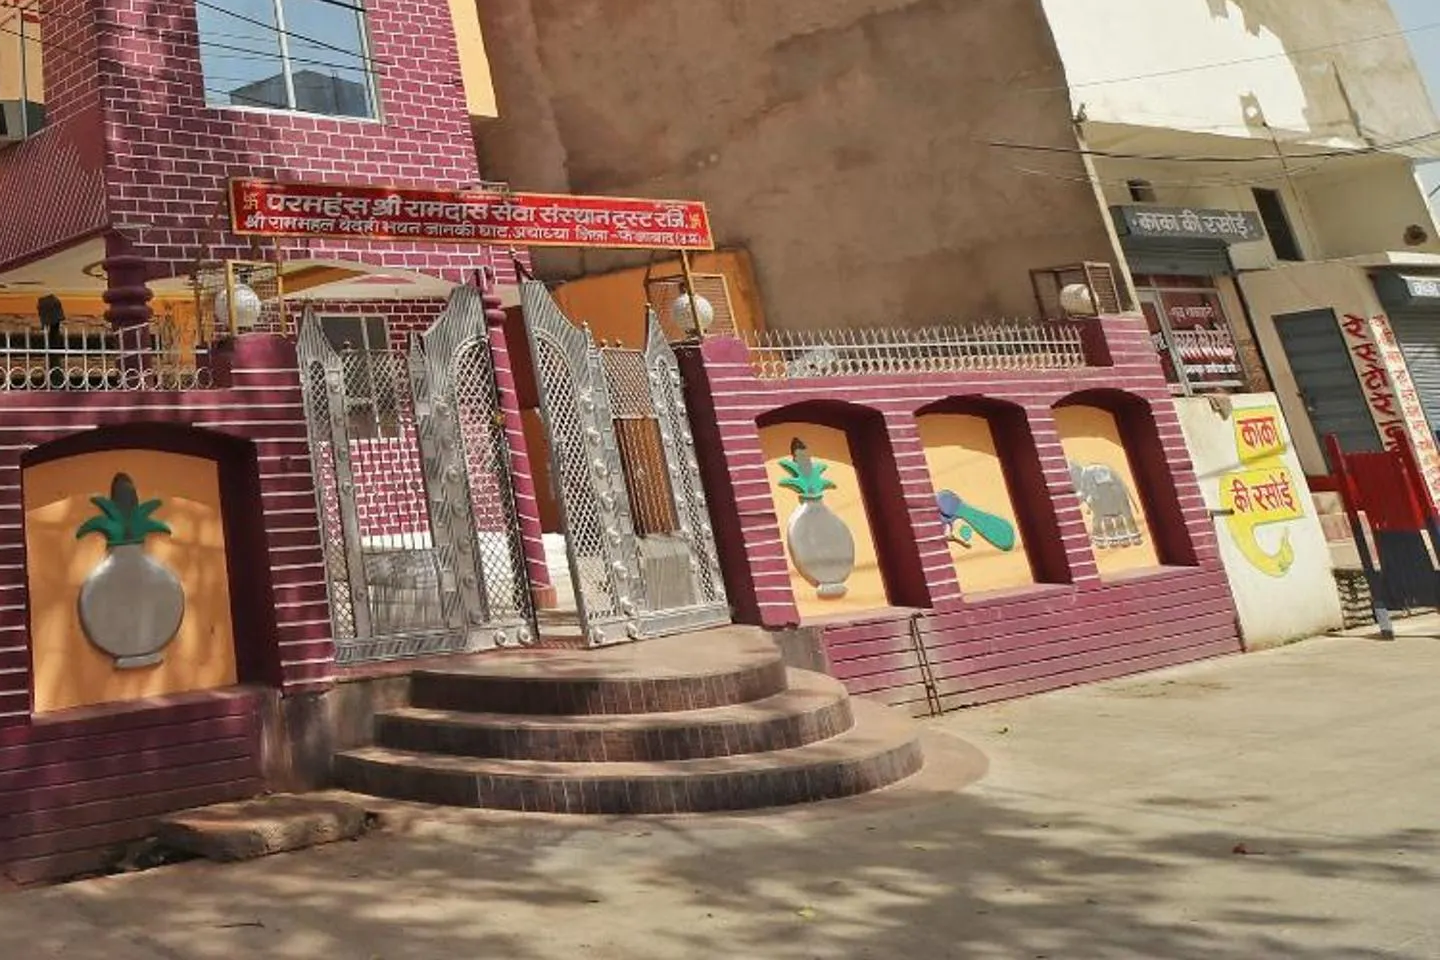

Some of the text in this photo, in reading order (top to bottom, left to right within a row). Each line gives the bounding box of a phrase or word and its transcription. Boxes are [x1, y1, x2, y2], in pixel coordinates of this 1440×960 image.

[245, 211, 264, 230] श्री
[266, 192, 369, 217] परमहंस
[371, 194, 401, 217] श्री
[403, 200, 488, 221] रामदास
[490, 199, 536, 222] सेवा
[538, 204, 610, 226] संस्थान
[611, 209, 653, 229] ट्रस्ट
[1136, 209, 1248, 239] काका की रसोई
[1237, 417, 1282, 447] काका
[1230, 472, 1297, 512] की रसोई
